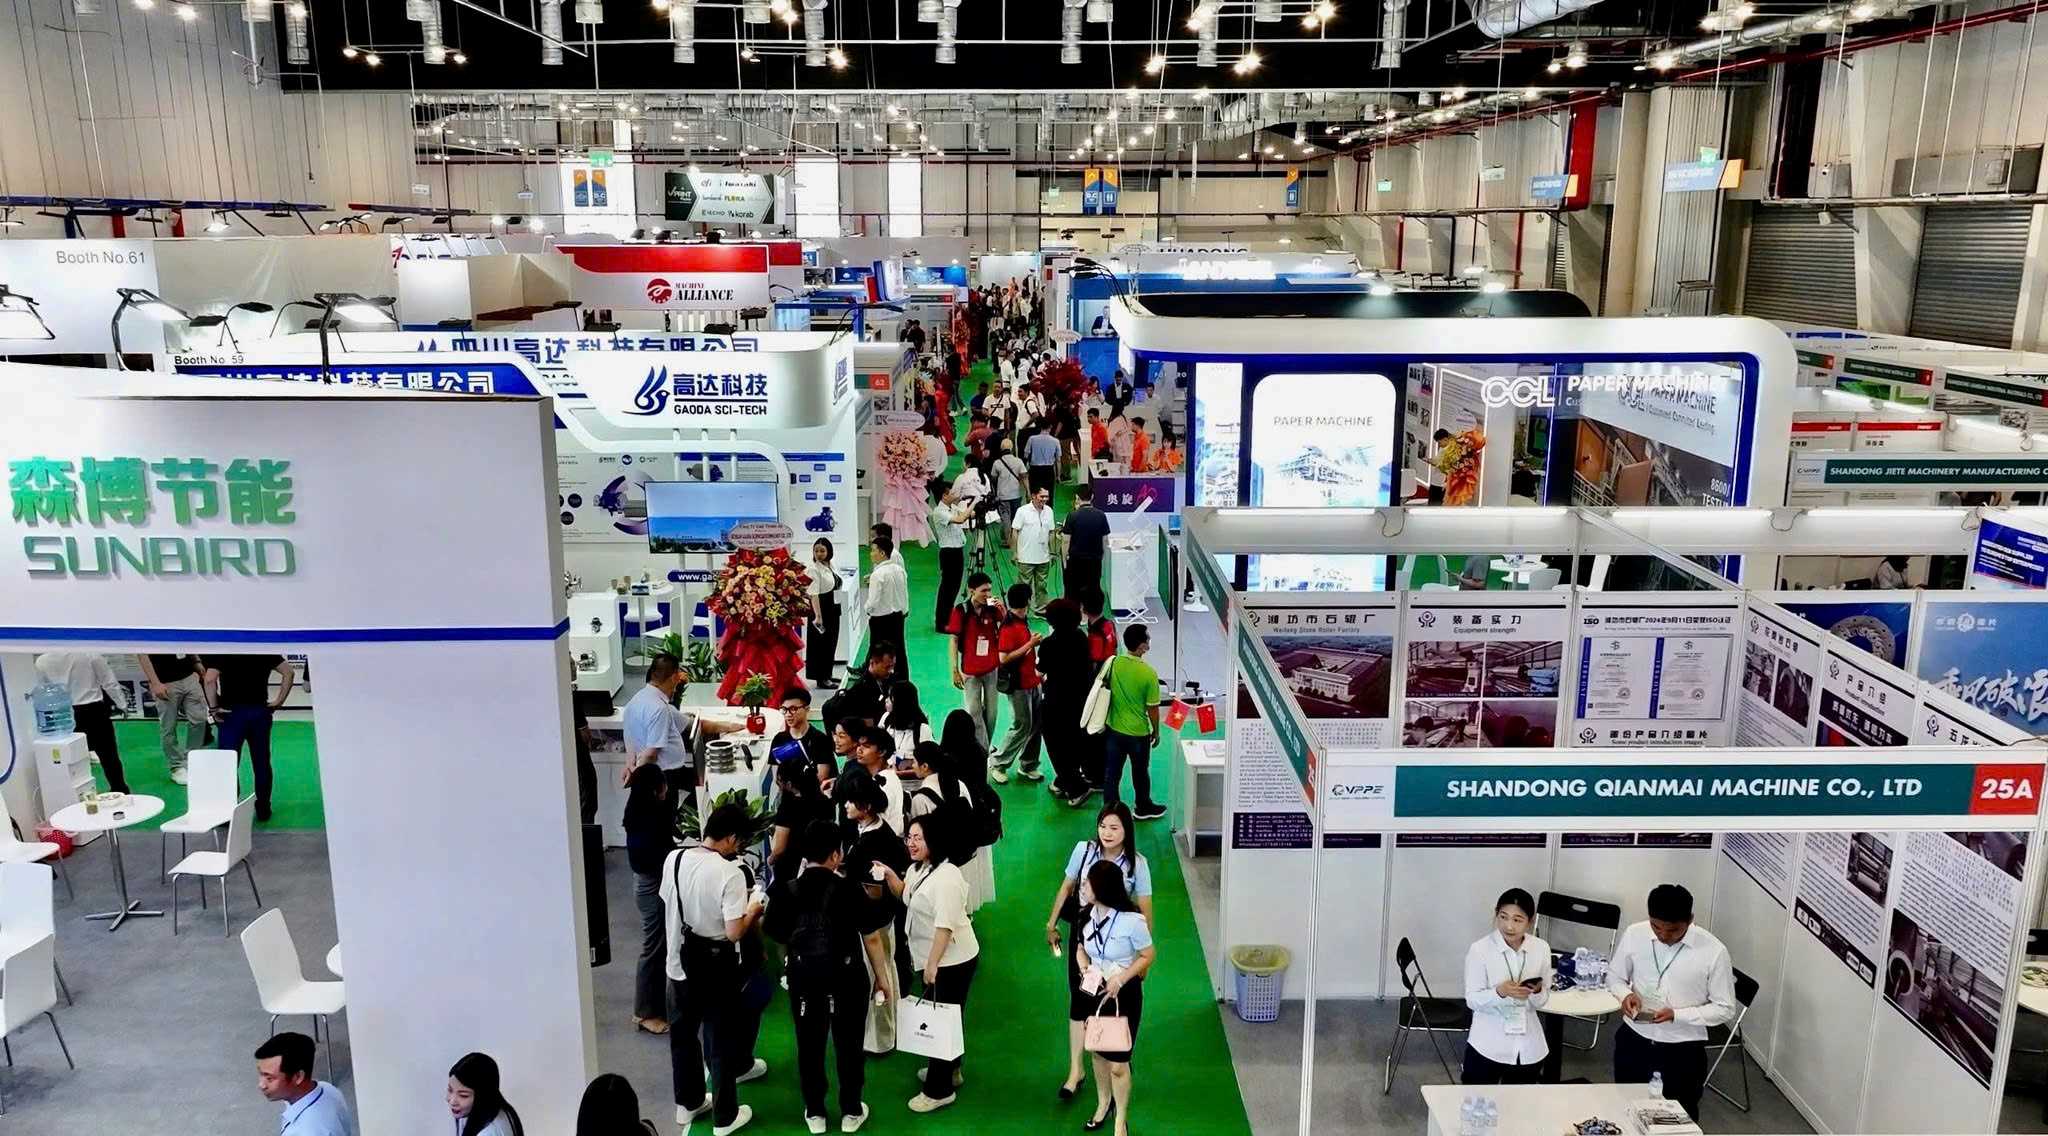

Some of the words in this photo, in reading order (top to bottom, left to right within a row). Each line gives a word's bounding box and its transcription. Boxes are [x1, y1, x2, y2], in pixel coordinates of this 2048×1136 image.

[56, 250, 99, 264] Booth
[103, 252, 146, 264] No.61
[675, 290, 734, 301] ALLIANCE
[174, 355, 207, 365] Booth
[673, 373, 768, 396] 高达科技
[1481, 376, 1556, 409] CCL
[1568, 375, 1628, 392] PAPER
[673, 404, 712, 416] GAODA
[714, 404, 768, 416] SCI-TECH
[1273, 415, 1313, 426] PAPER
[1315, 415, 1374, 426] MACHINE
[1830, 467, 1883, 476] SHANDONG
[1884, 467, 1905, 476] JIETE
[1907, 467, 1961, 476] MACHINERY
[1962, 467, 2041, 476] MANUFACTURING
[8, 456, 297, 528] 森博节能
[23, 536, 296, 577] SUNBIRD
[1453, 627, 1489, 635] Equipment
[1489, 627, 1517, 635] strength
[1447, 780, 1588, 798] SHANDONG
[1594, 779, 1703, 798] QIANMAI
[1710, 779, 1820, 797] MACHINE
[1827, 779, 1875, 798] CO.,
[1883, 778, 1923, 796] LTD
[1980, 778, 2034, 799] 25A
